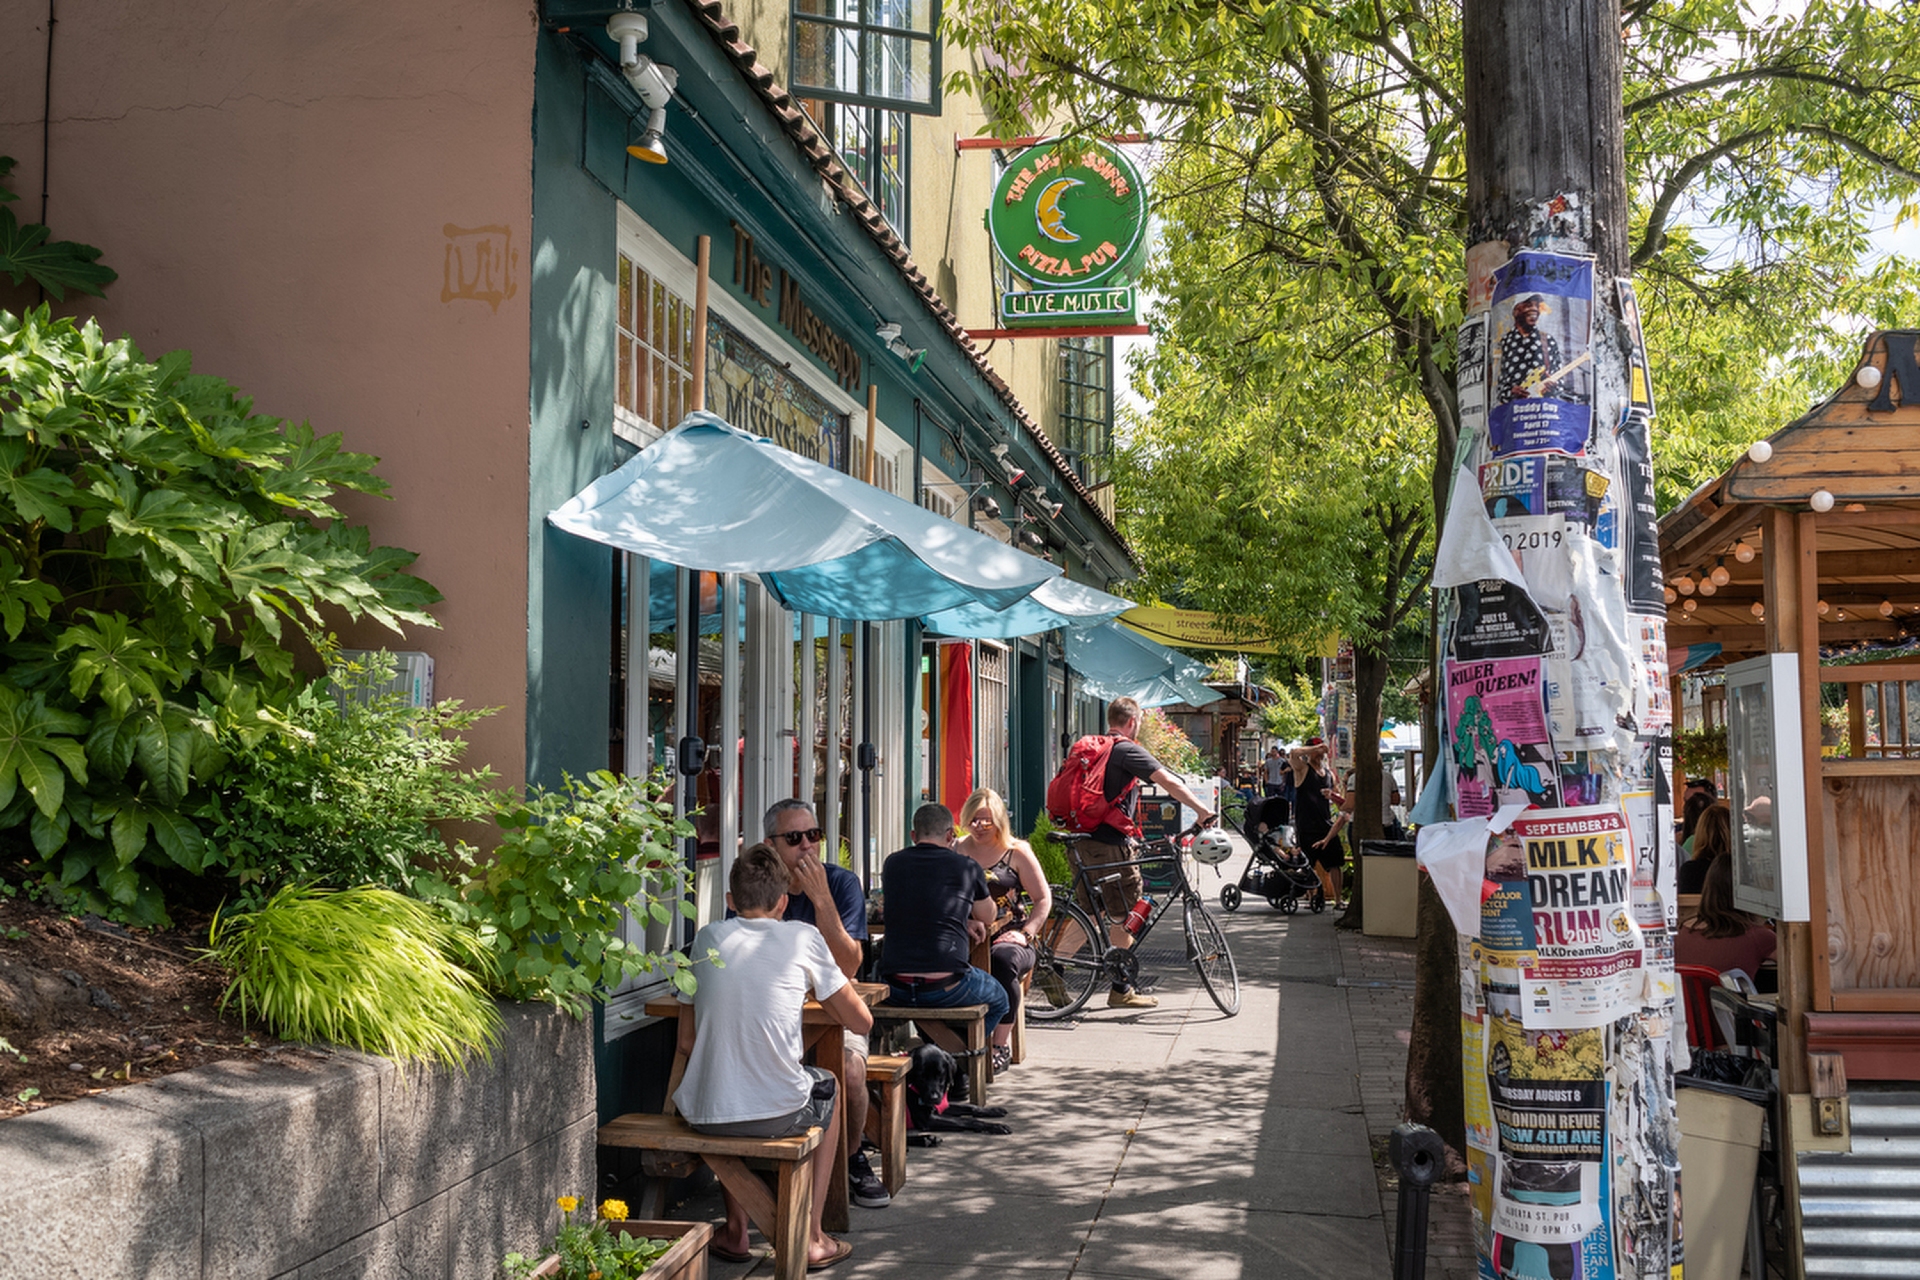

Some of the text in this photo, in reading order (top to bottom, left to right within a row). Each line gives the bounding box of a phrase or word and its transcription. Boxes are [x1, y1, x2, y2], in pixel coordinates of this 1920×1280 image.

[1006, 167, 1034, 204] THE
[1019, 240, 1118, 276] PIZZA PUB
[730, 219, 862, 393] The Mississippi
[1012, 291, 1125, 314] LIVE MUSIC
[1513, 401, 1558, 414] Buddy Guy
[1524, 420, 1541, 430] April
[1483, 460, 1536, 489] PRIDE
[1548, 500, 1577, 508] ESTIVAL
[1517, 530, 1562, 550] 2019
[1481, 611, 1507, 624] JULY 13
[1450, 662, 1495, 687] KILLER
[1475, 668, 1538, 698] QUEEN!
[1525, 817, 1620, 836] SEPTEMBER 7-8
[1530, 837, 1600, 868] MLK
[1493, 891, 1523, 901] MAJOR
[1528, 868, 1628, 909] DREAM
[1533, 909, 1601, 946] RUN
[1567, 927, 1601, 944] 2019
[1535, 1089, 1573, 1102] AUGUST
[1573, 1089, 1581, 1102] 8
[1509, 1111, 1557, 1129] ONDON
[1559, 1112, 1602, 1130] REVUE
[1511, 1127, 1533, 1143] SW
[1536, 1128, 1568, 1145] 4TH
[1570, 1129, 1602, 1145] AVE
[1554, 1211, 1571, 1222] PUB
[1542, 1225, 1561, 1235] 9PM
